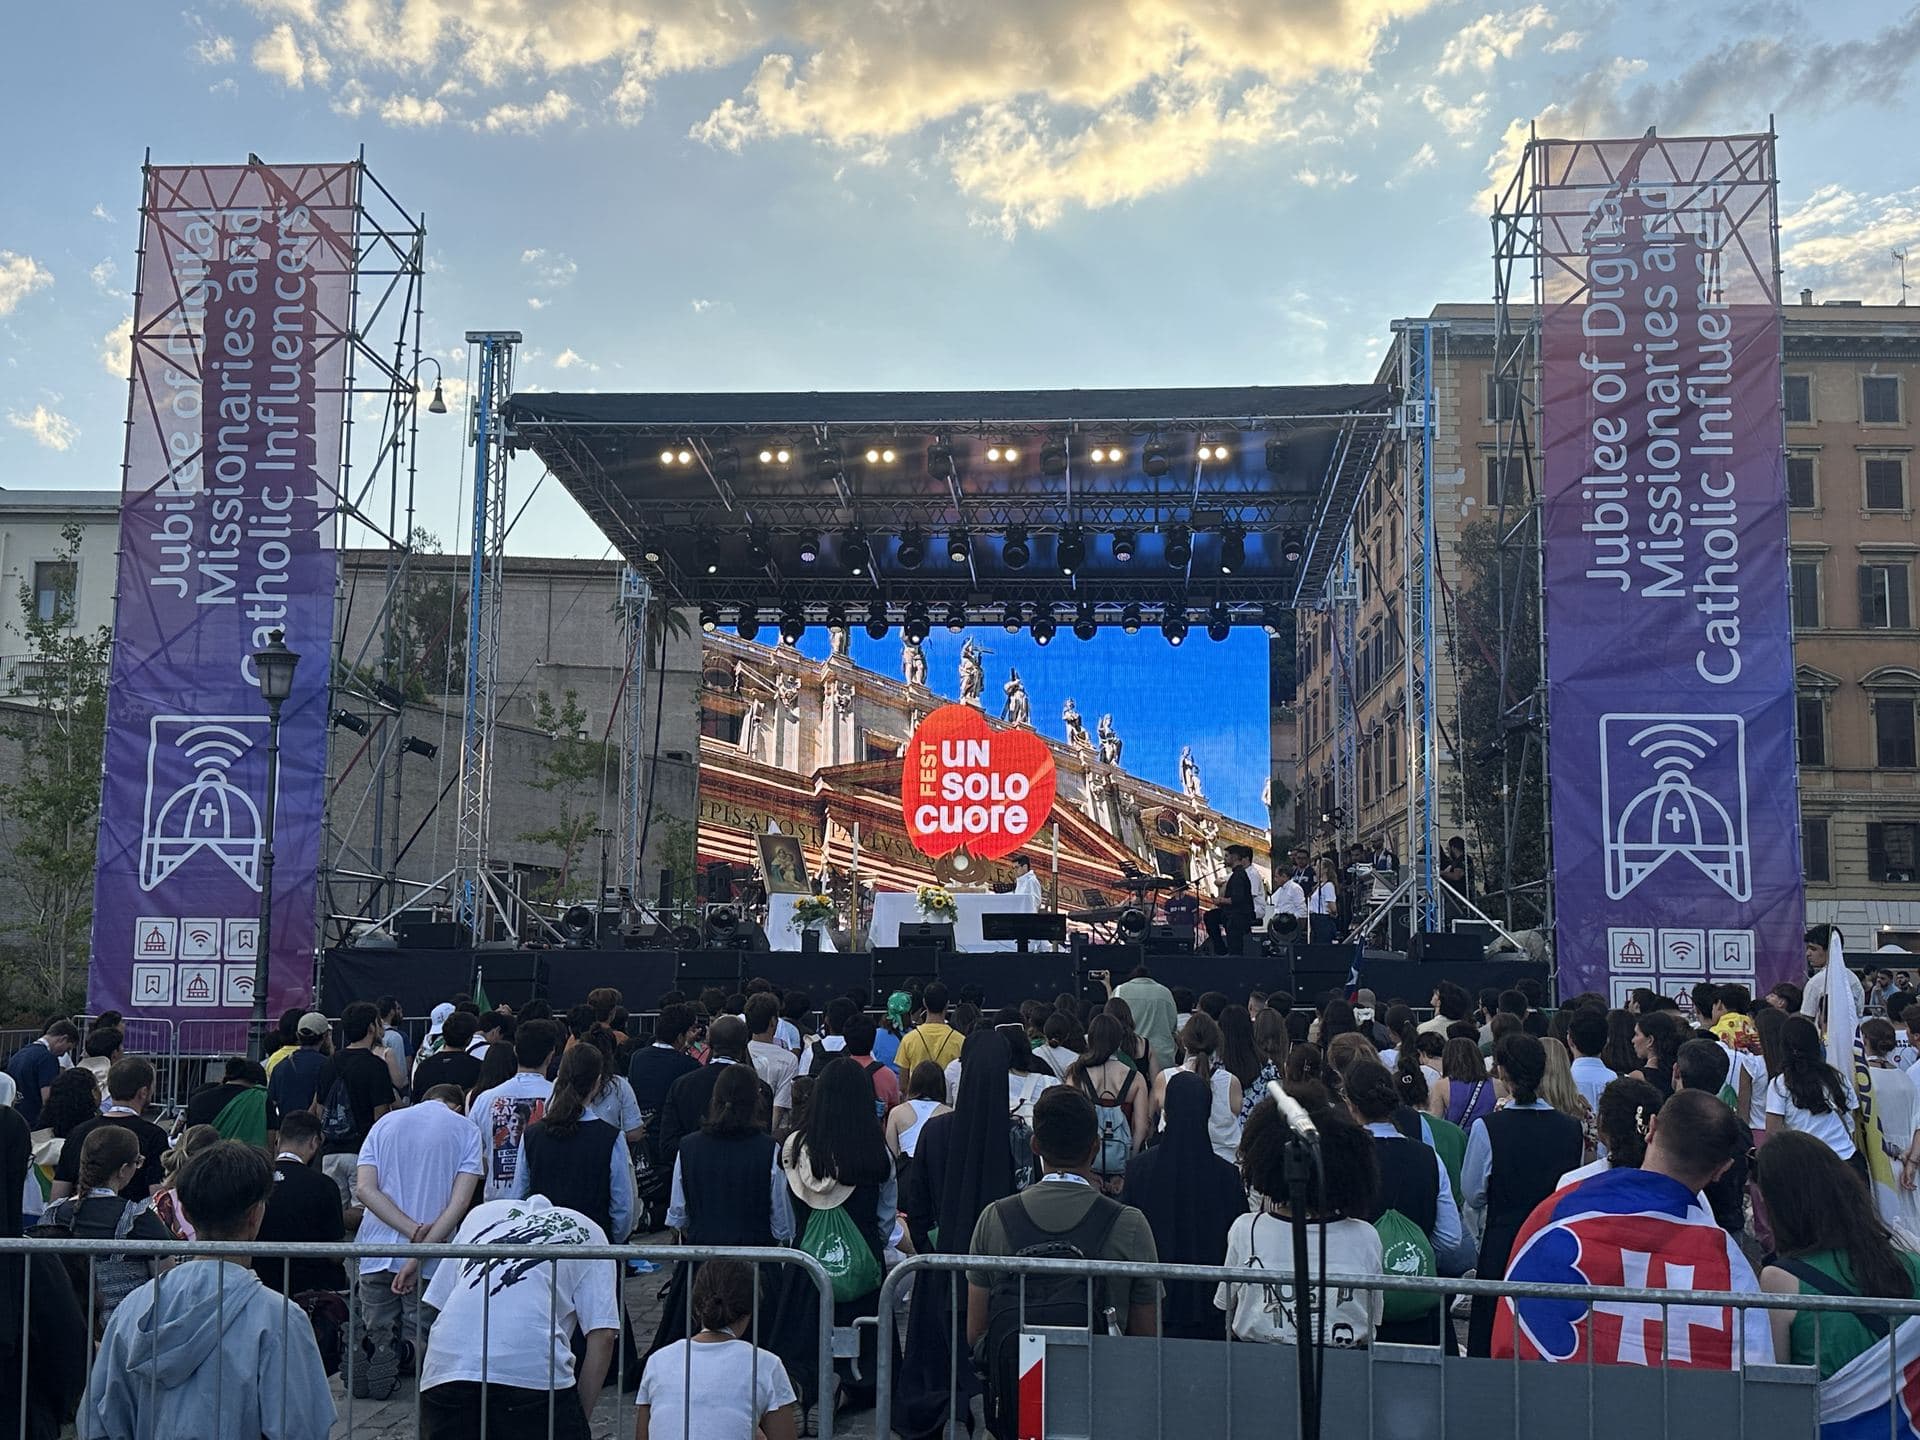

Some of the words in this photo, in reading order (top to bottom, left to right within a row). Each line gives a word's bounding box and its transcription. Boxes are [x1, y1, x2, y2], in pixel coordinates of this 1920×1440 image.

[167, 207, 222, 355] Digital
[222, 206, 263, 295] and
[1575, 180, 1639, 337] Digital
[1627, 177, 1677, 272] and
[163, 372, 202, 420] of
[256, 204, 311, 470] Influencers
[1579, 351, 1628, 403] of
[151, 432, 199, 598] Jubilee
[196, 306, 256, 605] Missionaries
[1582, 416, 1631, 593] Jubilee
[1633, 284, 1685, 598] Missionaries
[1690, 470, 1741, 685] Catholic
[920, 741, 938, 797] FEST
[941, 772, 1030, 801] SOLO
